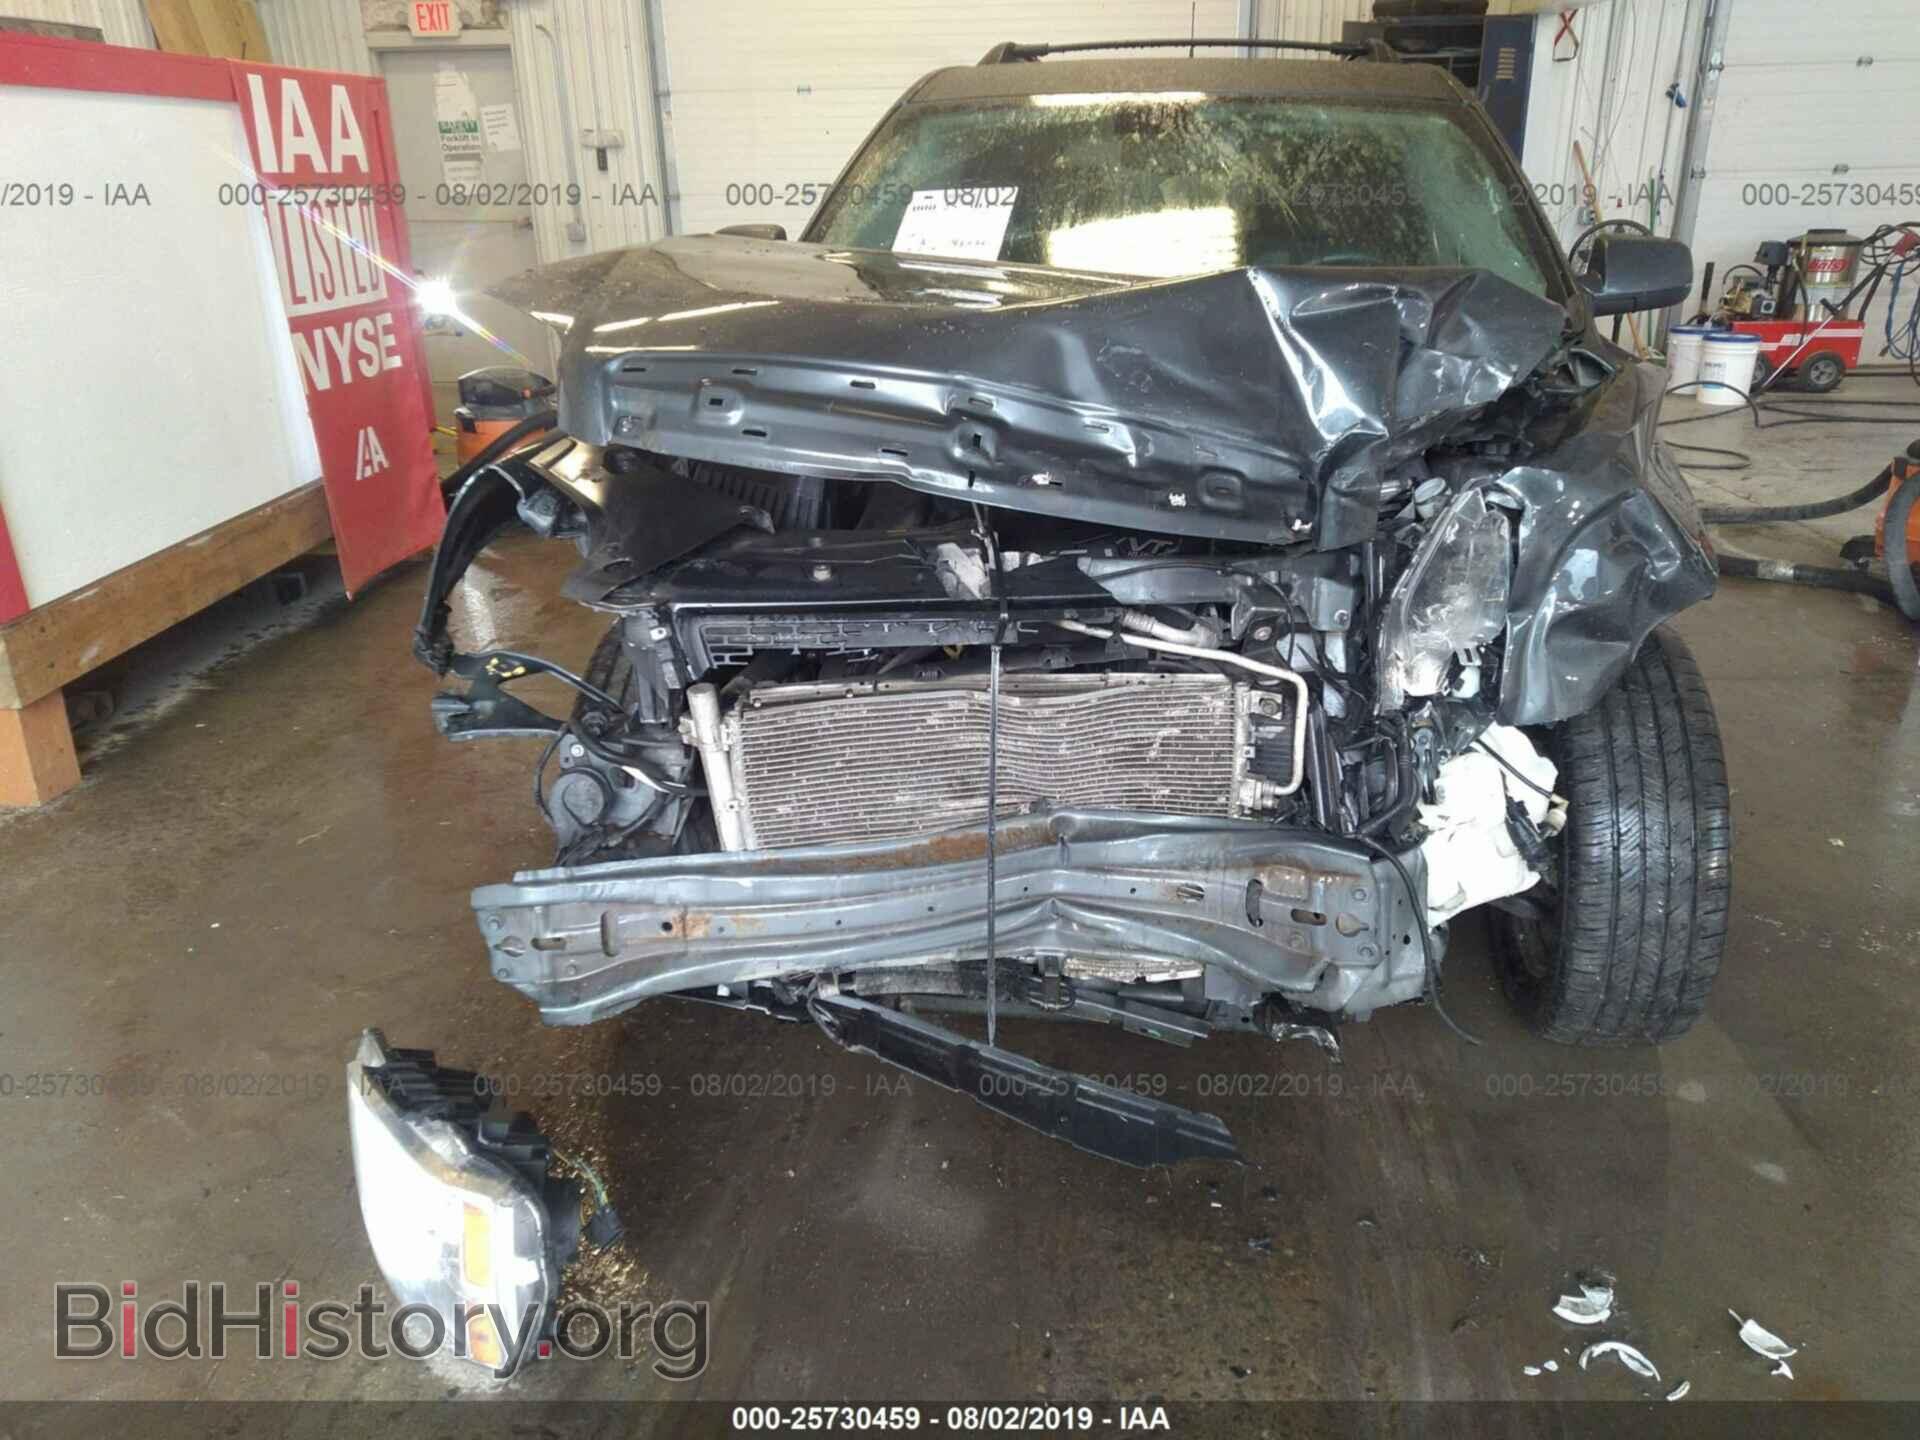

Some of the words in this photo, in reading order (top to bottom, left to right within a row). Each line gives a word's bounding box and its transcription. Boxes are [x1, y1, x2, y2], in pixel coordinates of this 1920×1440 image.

[416, 3, 449, 31] EXIT
[247, 73, 370, 173] IAA
[278, 198, 379, 305] LISTED
[291, 312, 403, 395] NYSE
